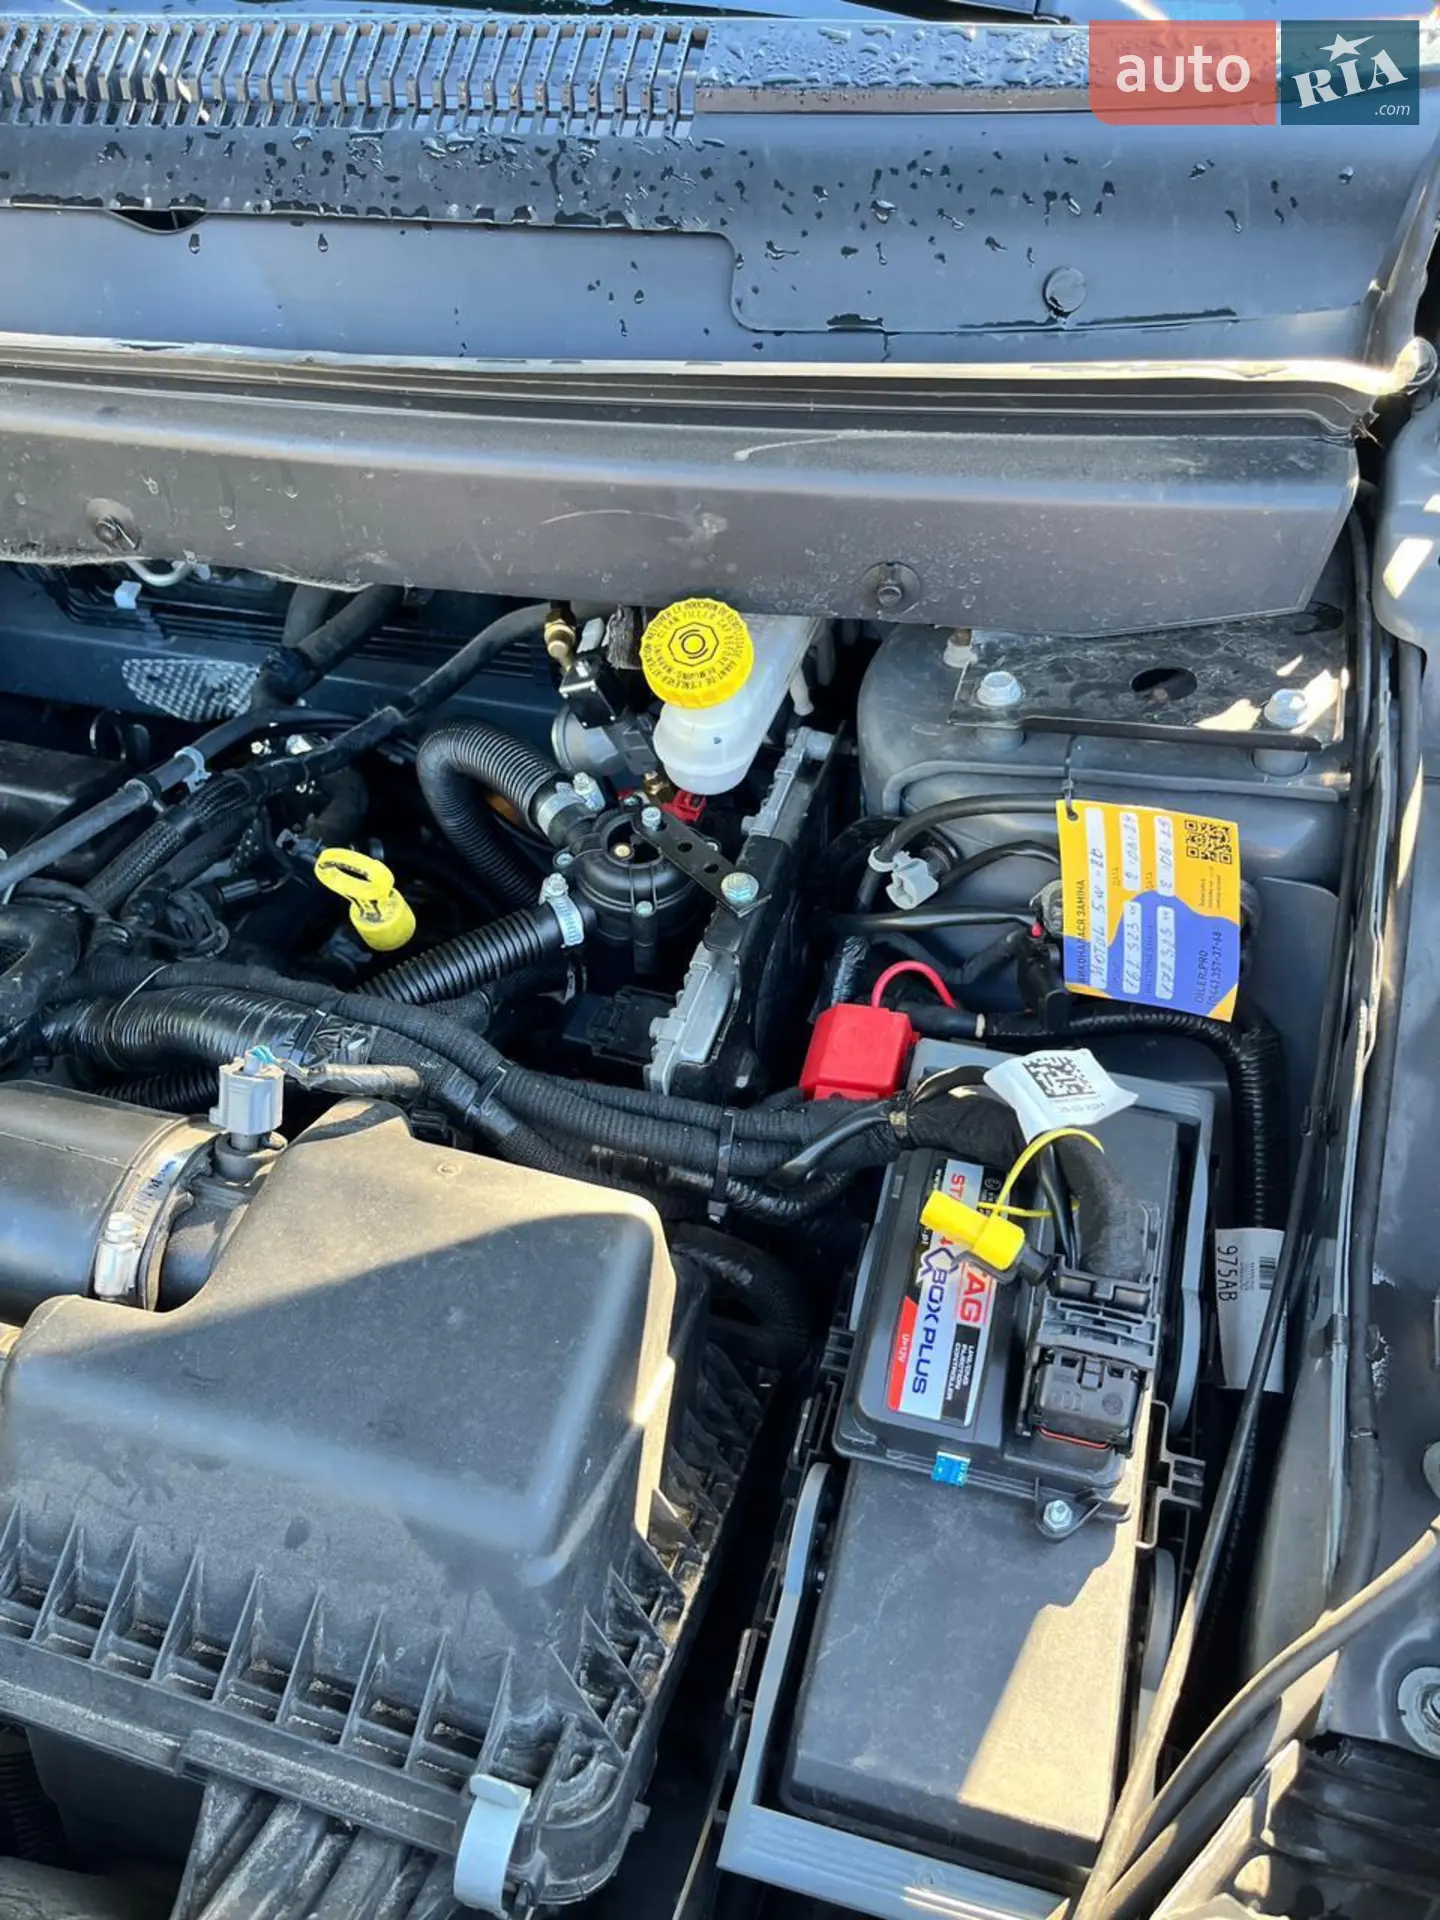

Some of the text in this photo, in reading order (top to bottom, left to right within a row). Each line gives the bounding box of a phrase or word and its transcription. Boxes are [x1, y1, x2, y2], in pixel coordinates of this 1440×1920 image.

[655, 615, 681, 638] CLEAN
[1077, 878, 1087, 922] ЗАМІНА
[1216, 1244, 1239, 1302] 975AB
[911, 1327, 938, 1395] PLUS
[945, 1341, 961, 1401] CONTROLLER
